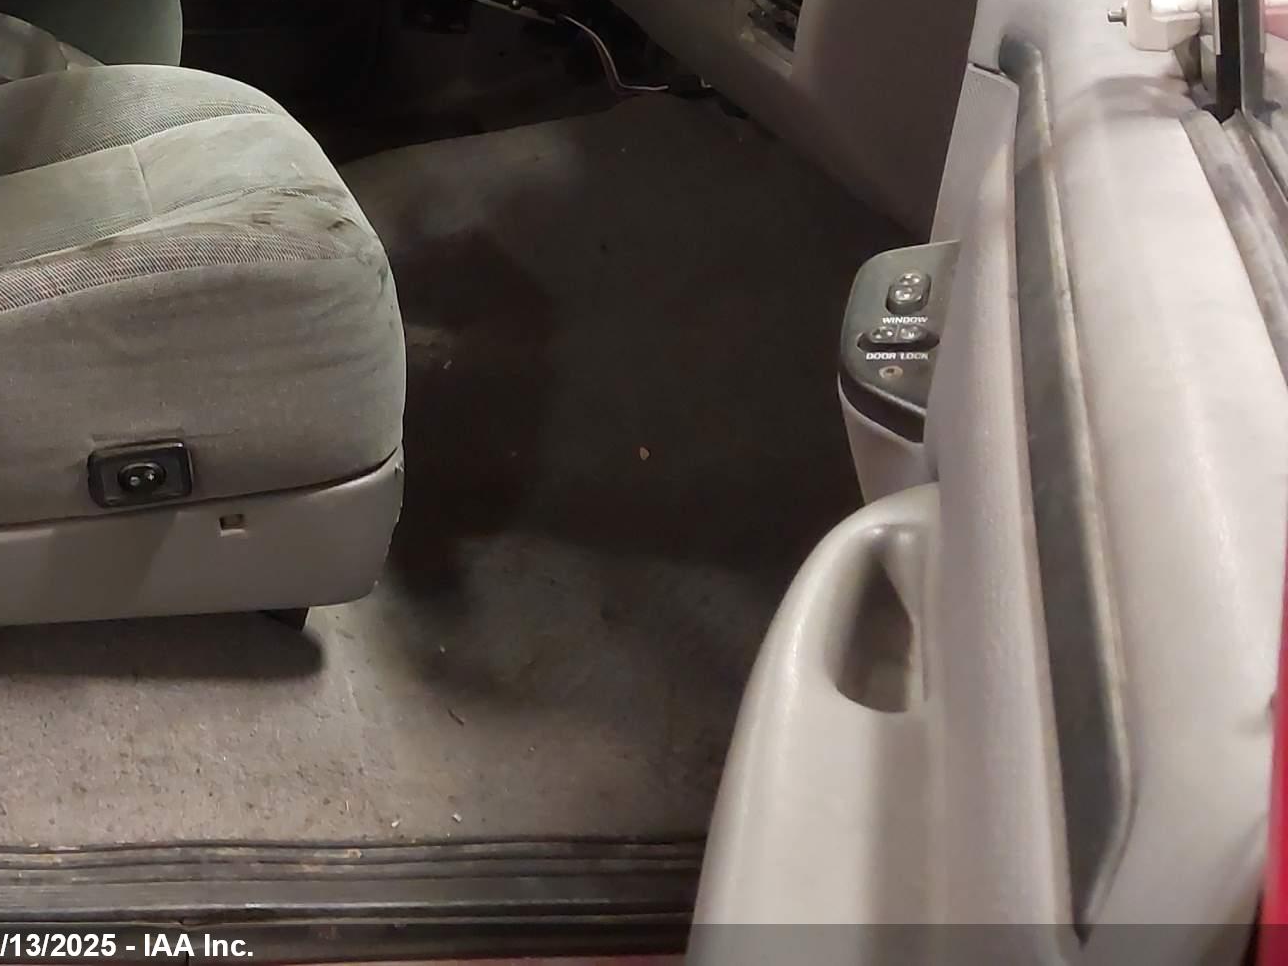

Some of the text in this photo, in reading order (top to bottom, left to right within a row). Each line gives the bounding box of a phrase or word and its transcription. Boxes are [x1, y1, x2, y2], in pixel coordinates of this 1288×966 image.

[881, 316, 928, 324] WINDOW
[865, 352, 929, 360] DOOR LOCK
